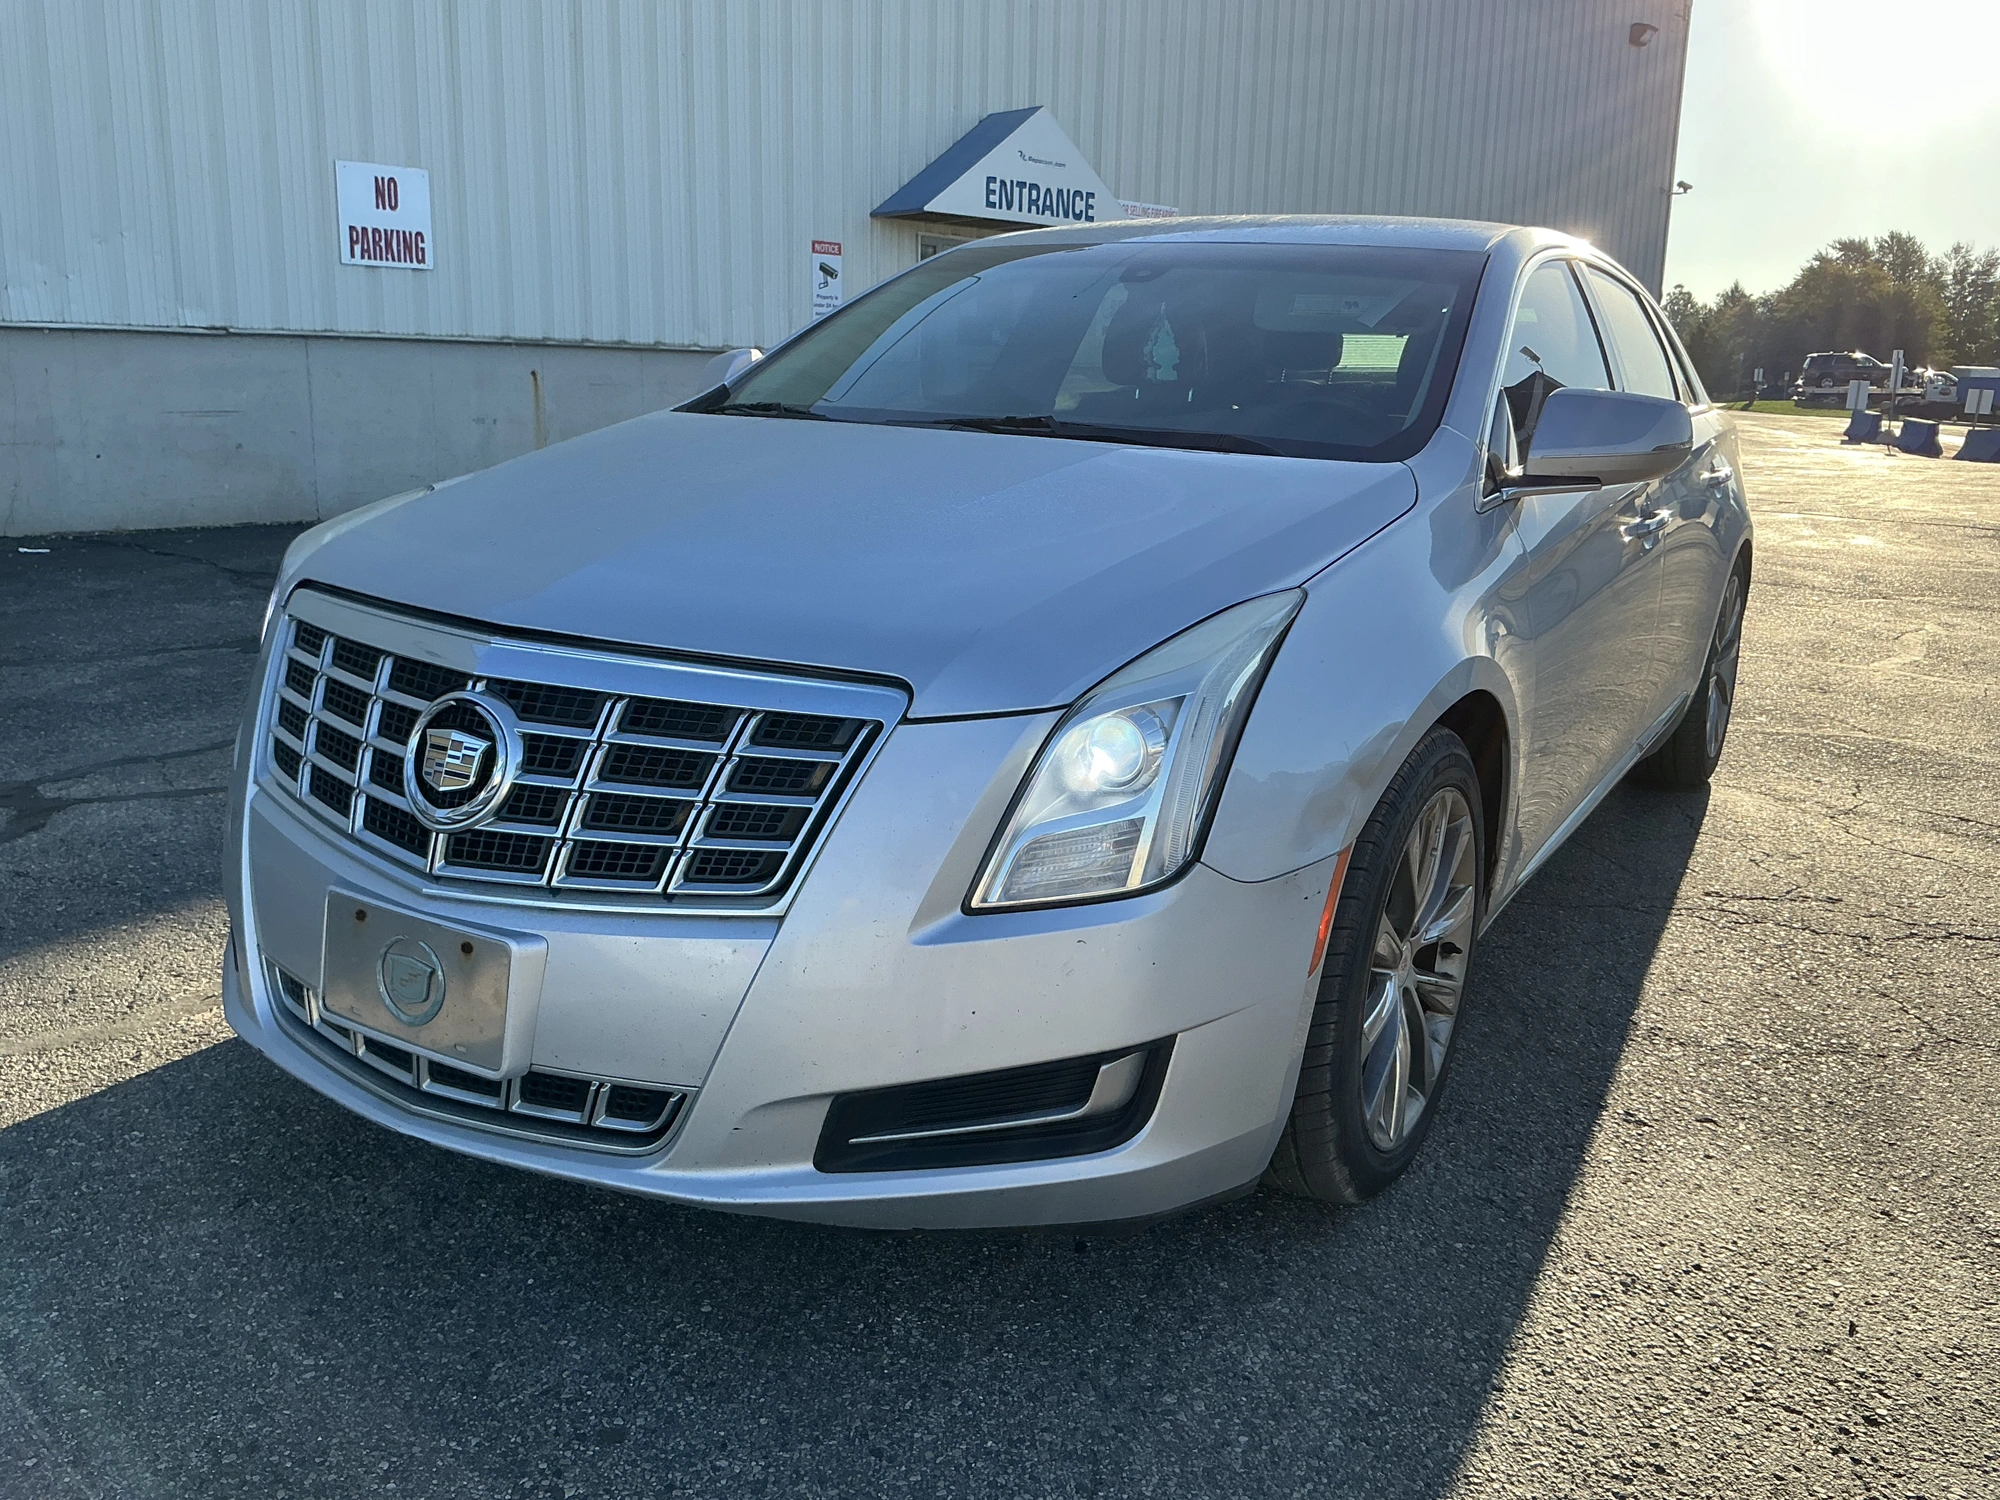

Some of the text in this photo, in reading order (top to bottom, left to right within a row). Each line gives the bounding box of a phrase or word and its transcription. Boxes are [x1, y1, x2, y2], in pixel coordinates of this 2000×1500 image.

[374, 175, 399, 211] NO
[985, 176, 1095, 222] ENTRANCE
[1129, 205, 1150, 218] SELLING
[349, 225, 426, 264] PARKING
[814, 243, 840, 254] NOTICE
